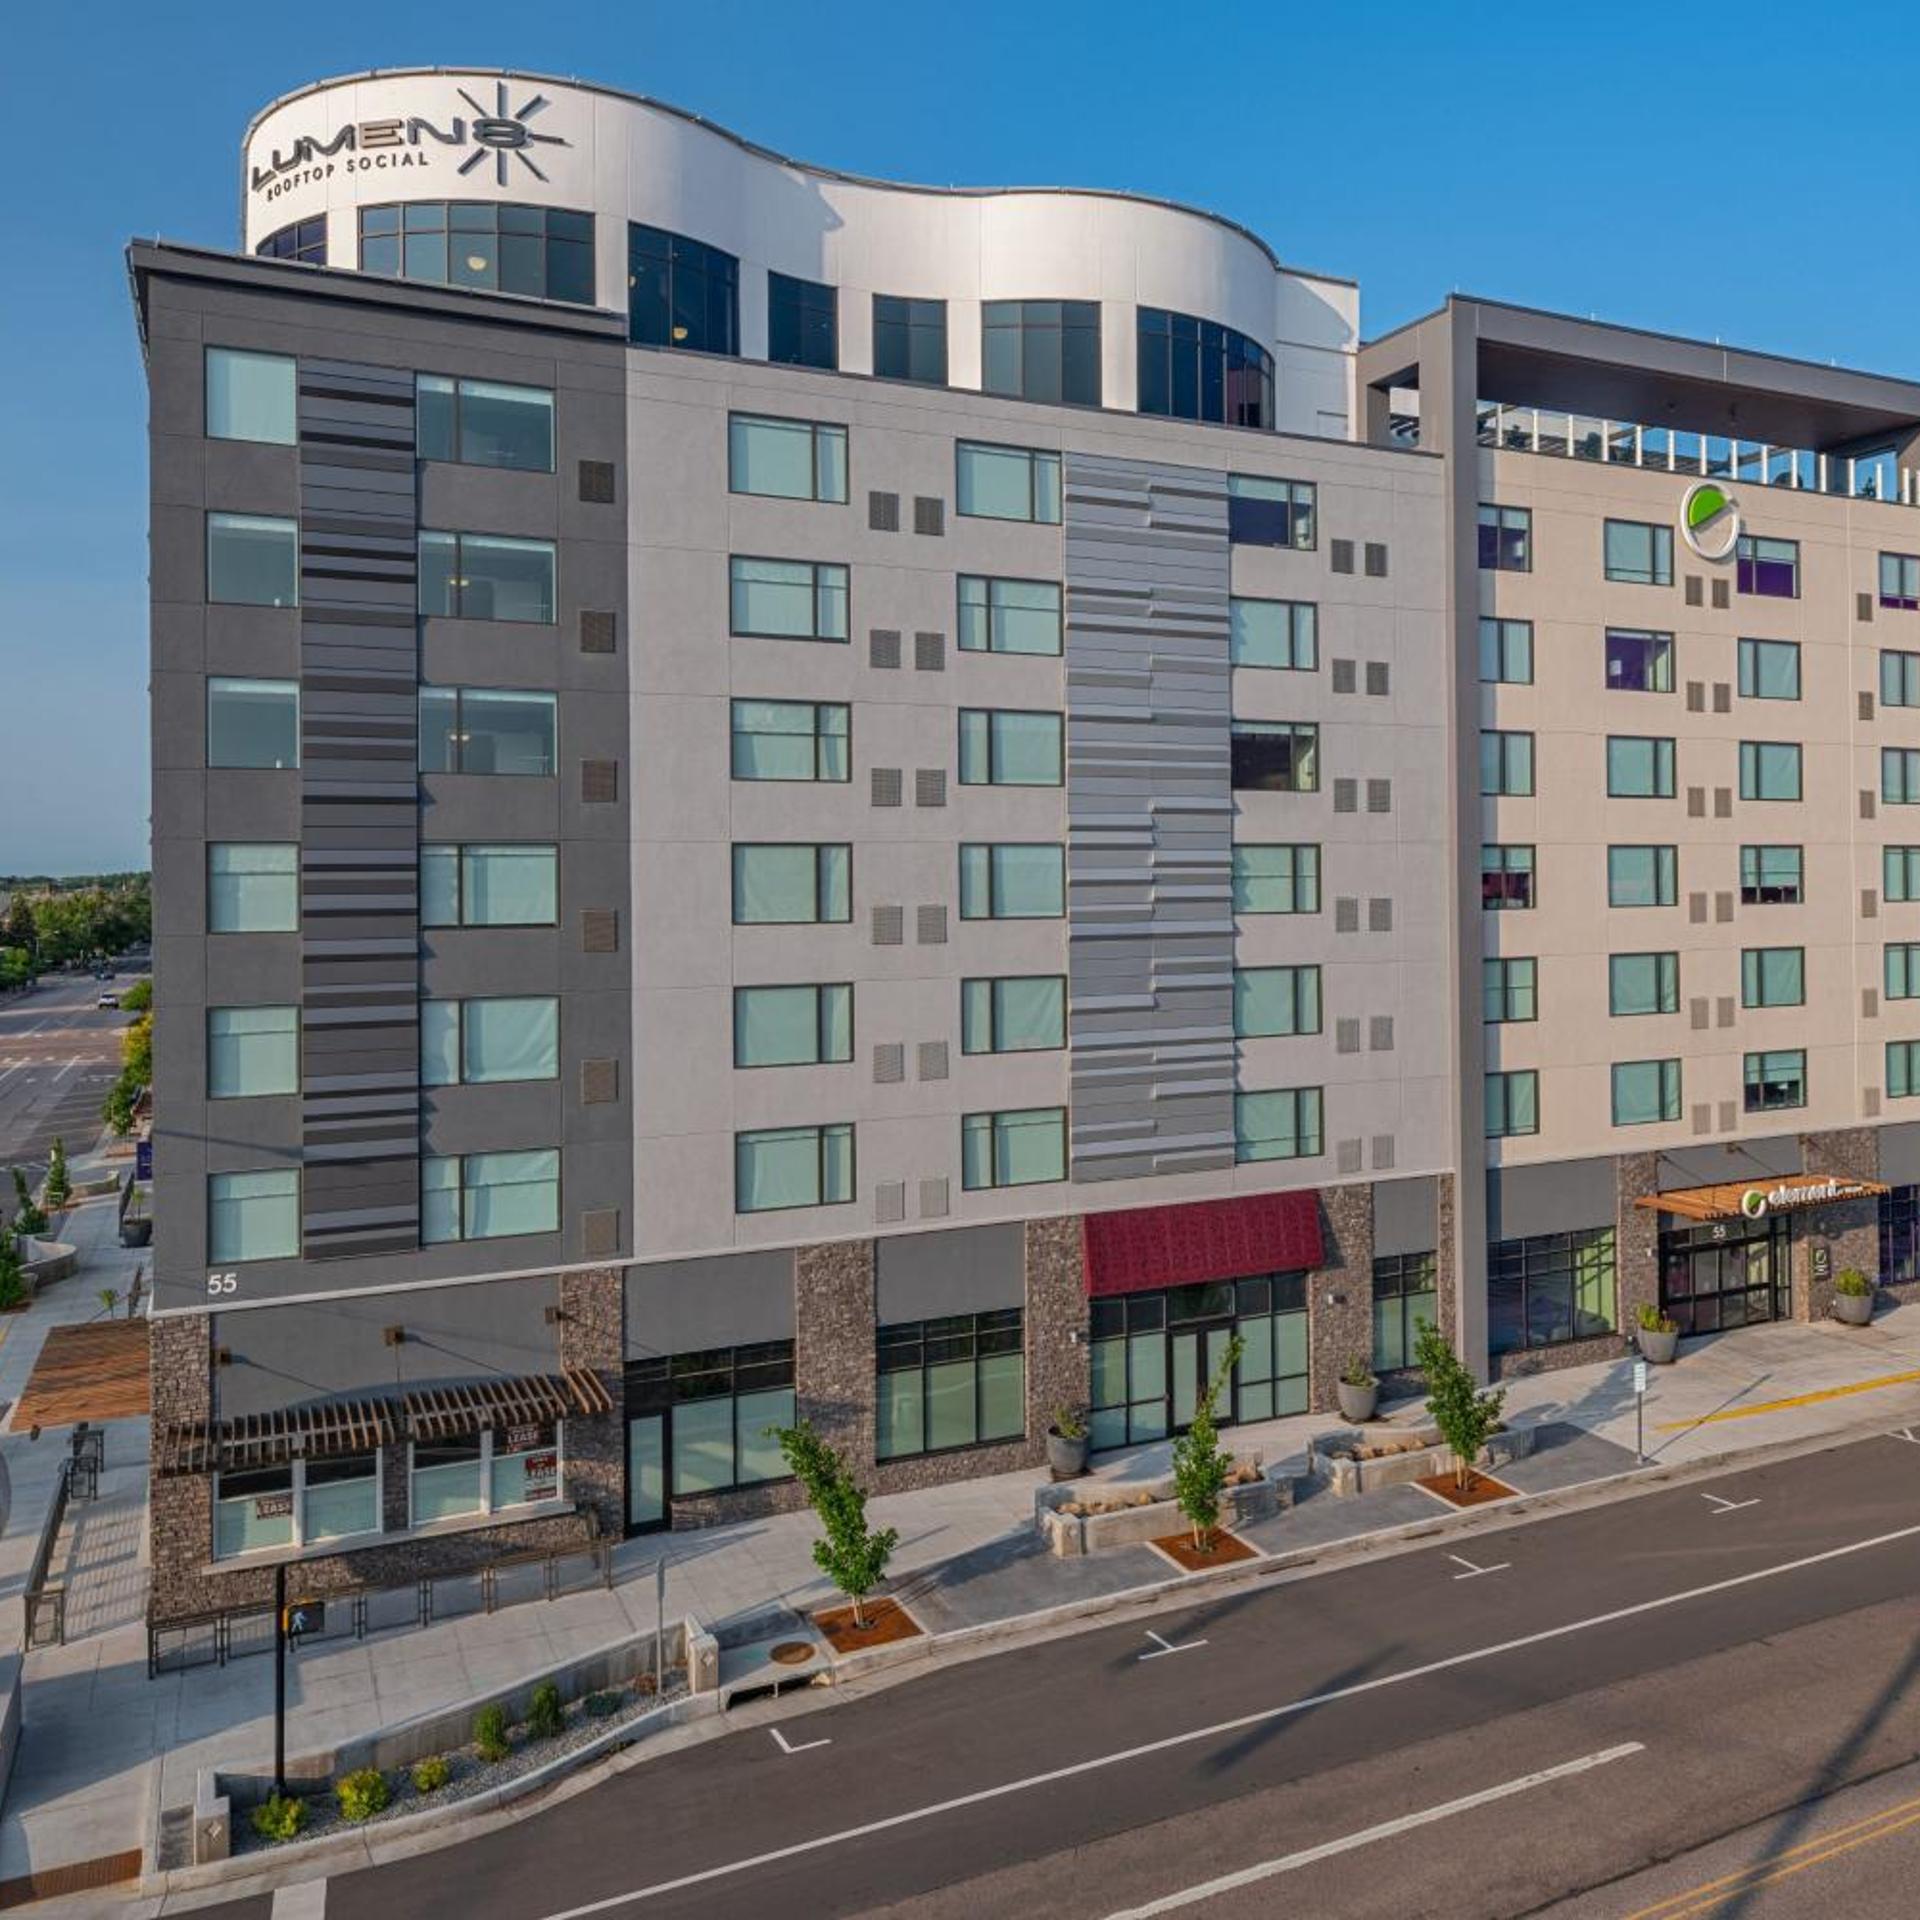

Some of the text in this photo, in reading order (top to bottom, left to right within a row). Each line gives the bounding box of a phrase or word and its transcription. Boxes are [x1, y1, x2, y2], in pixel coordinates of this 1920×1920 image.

[252, 116, 529, 193] LUMEN8
[266, 152, 429, 202] ROOFTOP SOCIAL
[1711, 1225, 1726, 1239] 55
[208, 1273, 237, 1295] 55
